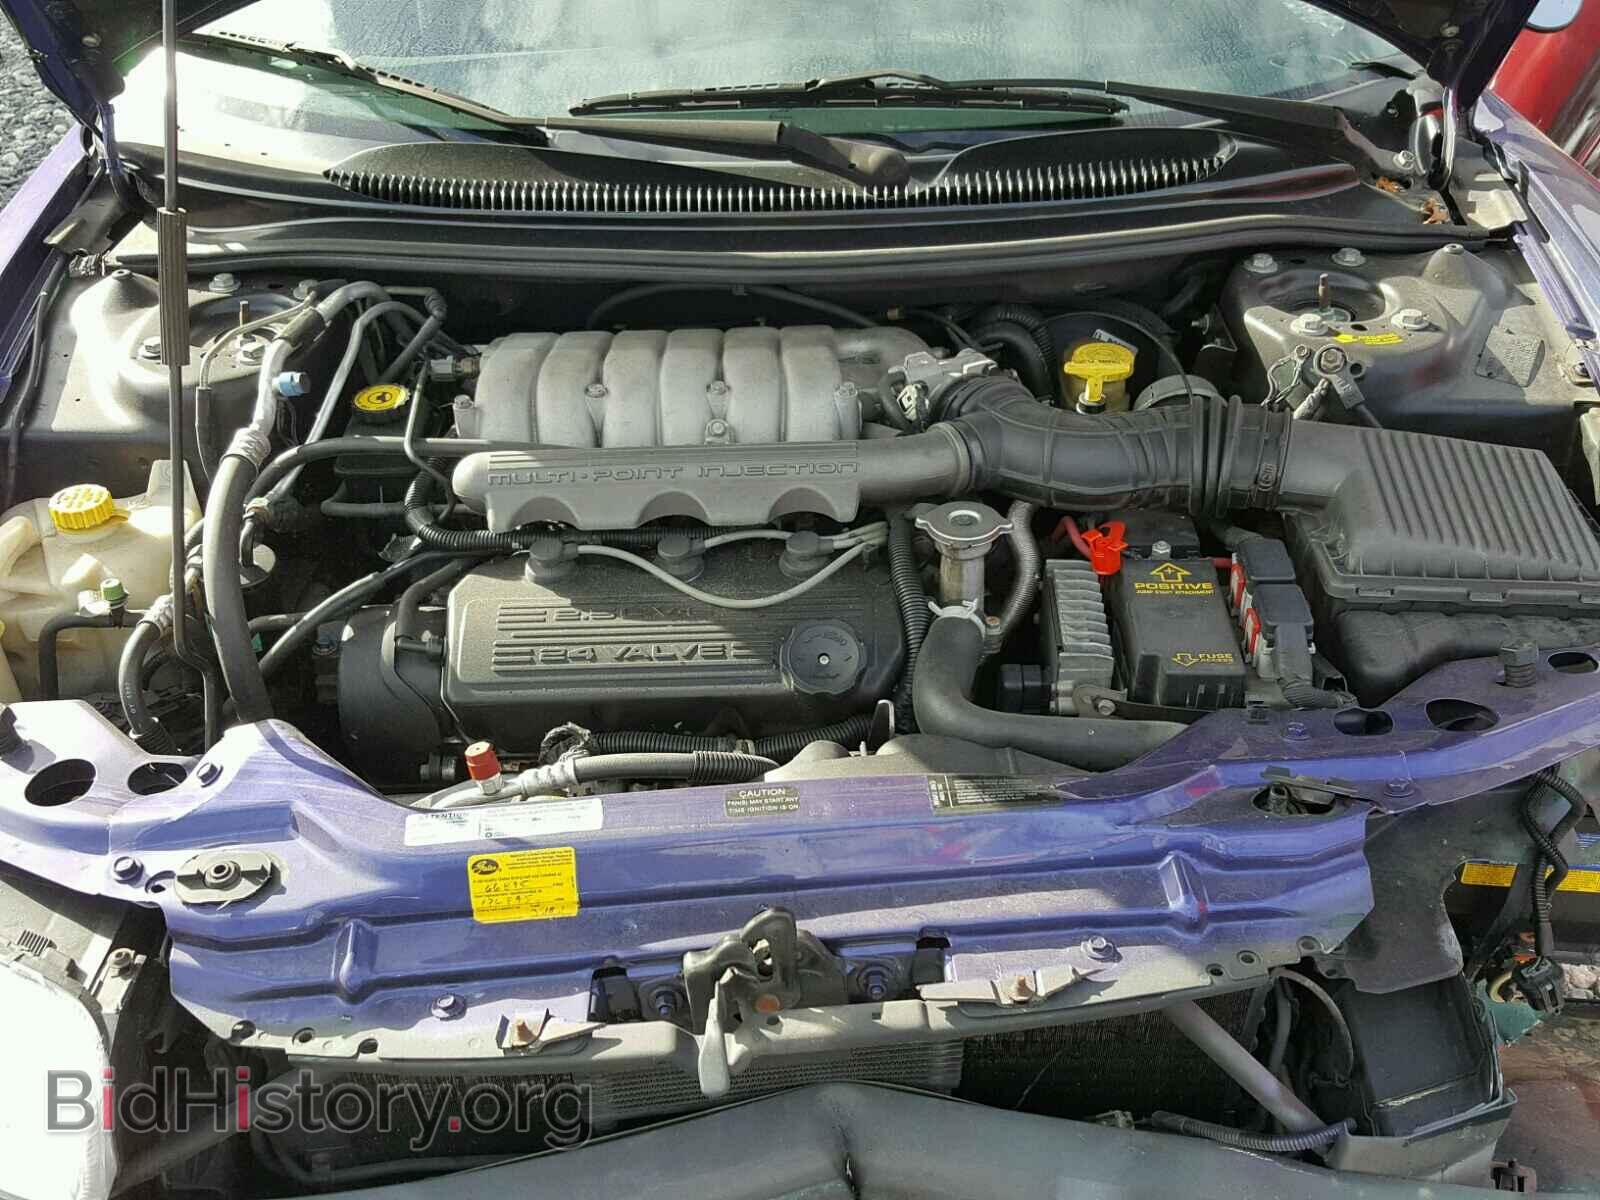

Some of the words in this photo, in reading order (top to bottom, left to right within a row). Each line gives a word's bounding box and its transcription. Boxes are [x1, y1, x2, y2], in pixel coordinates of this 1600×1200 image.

[698, 461, 859, 478] INJECTION
[1135, 582, 1215, 590] POSITIVE
[538, 646, 597, 663] 24
[604, 641, 728, 661] VALVE
[738, 788, 786, 798] CAUTION
[727, 807, 745, 815] TIME
[747, 805, 778, 813] IGNITION
